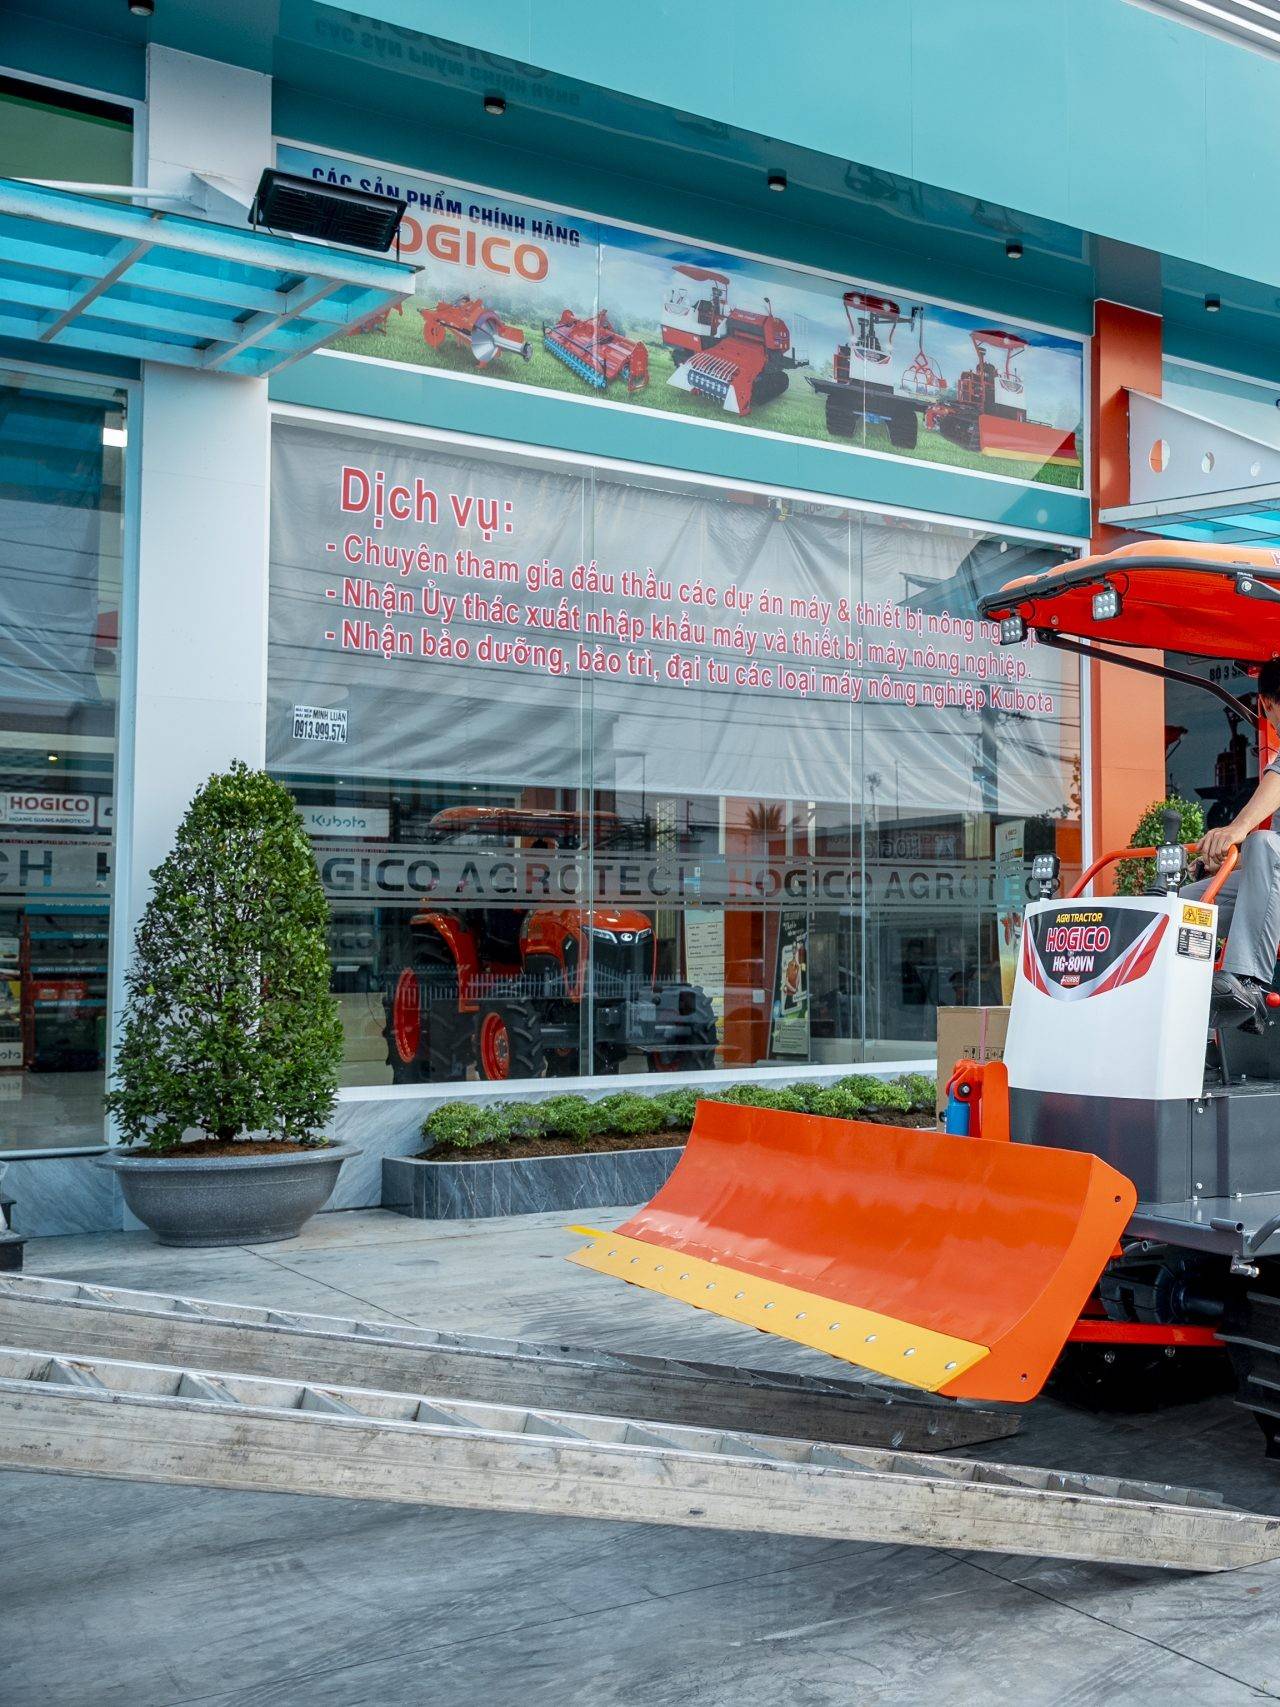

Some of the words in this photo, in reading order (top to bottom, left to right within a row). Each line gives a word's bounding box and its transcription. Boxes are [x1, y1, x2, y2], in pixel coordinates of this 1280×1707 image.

[407, 190, 462, 219] PHẨM
[469, 205, 526, 234] CHÍNH
[531, 219, 580, 247] HÃNG
[393, 215, 549, 283] OGICO
[341, 465, 438, 529] Dịch
[450, 493, 514, 542] vụ:
[343, 534, 448, 577] Chuyên
[455, 550, 519, 582] tham
[526, 559, 564, 593] gia
[570, 560, 614, 594] đấu
[621, 567, 672, 601] thầu
[679, 579, 717, 607] các
[724, 584, 753, 615] dự
[759, 588, 783, 615] án
[790, 595, 831, 625] máy
[837, 598, 850, 622] &
[856, 599, 901, 629] thiết
[905, 607, 922, 638] bị
[928, 611, 975, 643] nông
[342, 577, 415, 618] Nhận
[422, 579, 457, 624] Ủy
[463, 594, 519, 625] thác
[525, 597, 580, 631] xuất
[586, 607, 645, 644] nhập
[651, 611, 706, 645] khẩu
[712, 623, 758, 656] máy
[763, 628, 787, 654] và
[792, 628, 840, 660] thiết
[845, 635, 863, 667] bị
[868, 640, 907, 671] máy
[912, 645, 960, 677] nông
[965, 651, 1032, 683] nghiệp.
[342, 619, 414, 660] Nhận
[421, 627, 470, 659] bảo
[477, 634, 570, 675] dưỡng,
[577, 643, 622, 674] bảo
[627, 648, 660, 682] trì,
[666, 653, 701, 686] đại
[707, 658, 730, 685] tu
[735, 662, 772, 688] các
[778, 664, 816, 697] loại
[822, 671, 863, 702] máy
[868, 674, 916, 708] nông
[922, 680, 986, 712] nghiệp
[990, 686, 1053, 713] Kubota
[10, 796, 90, 812] HOGICO
[311, 814, 367, 829] Kubota
[322, 857, 441, 893] GICO
[455, 860, 701, 897] AGROTECH
[728, 866, 873, 899] HOGICO
[884, 871, 1047, 901] AGROTEC
[1056, 914, 1070, 923] AGRI
[1070, 913, 1103, 922] TRACTOR
[1045, 926, 1111, 952] HOGICO
[1052, 956, 1094, 972] HG-80VN
